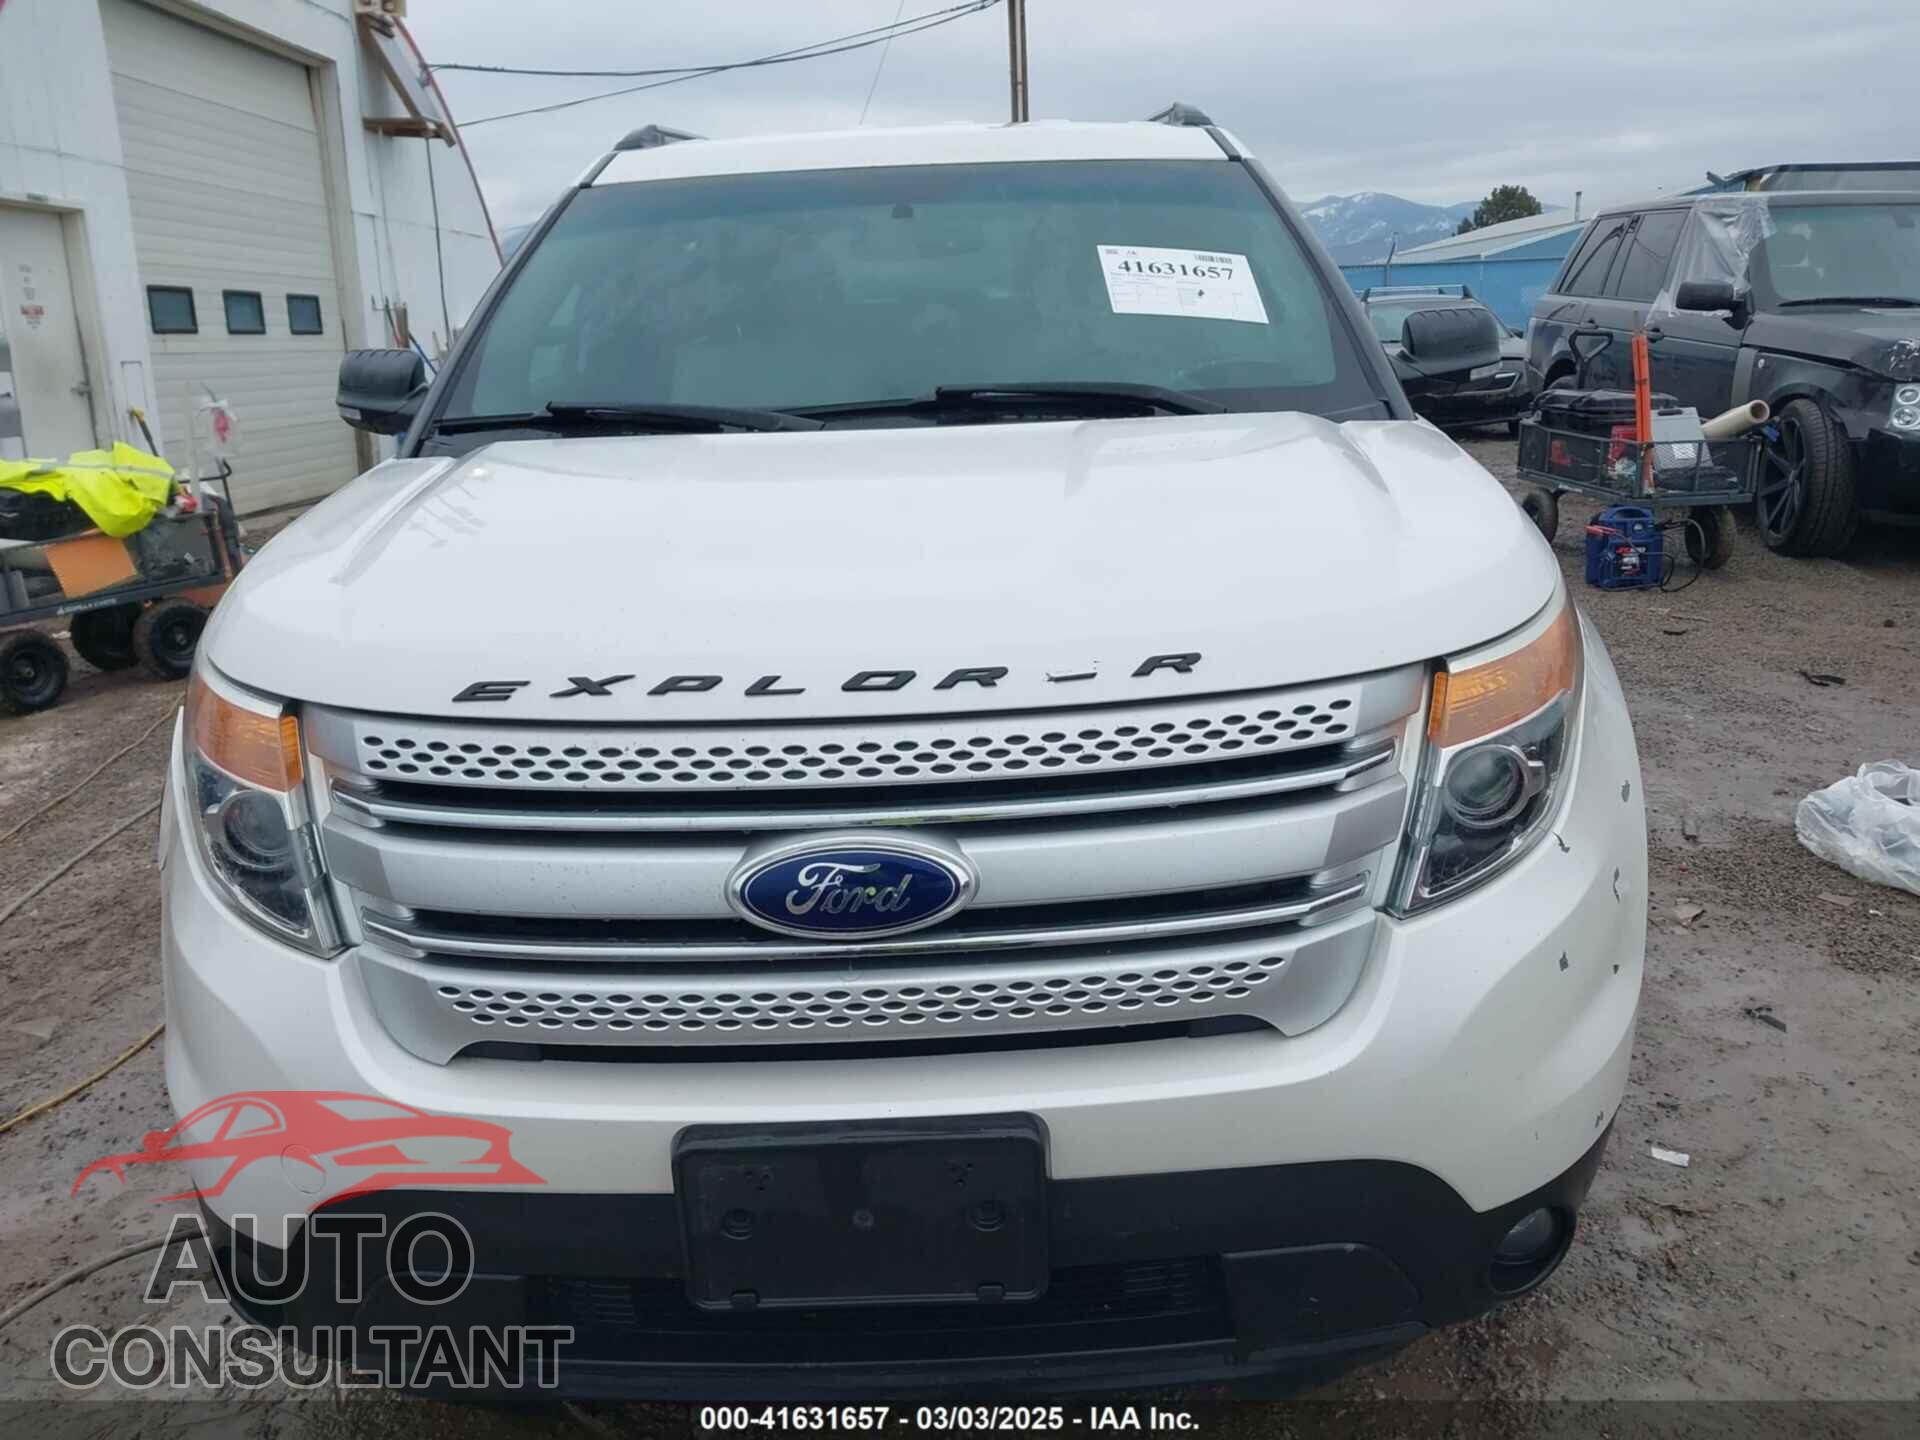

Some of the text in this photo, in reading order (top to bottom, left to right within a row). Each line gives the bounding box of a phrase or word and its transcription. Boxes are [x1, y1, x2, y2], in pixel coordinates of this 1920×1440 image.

[1117, 259, 1233, 281] 41631657
[451, 651, 1202, 703] EXPLORR
[785, 861, 913, 915] Ford
